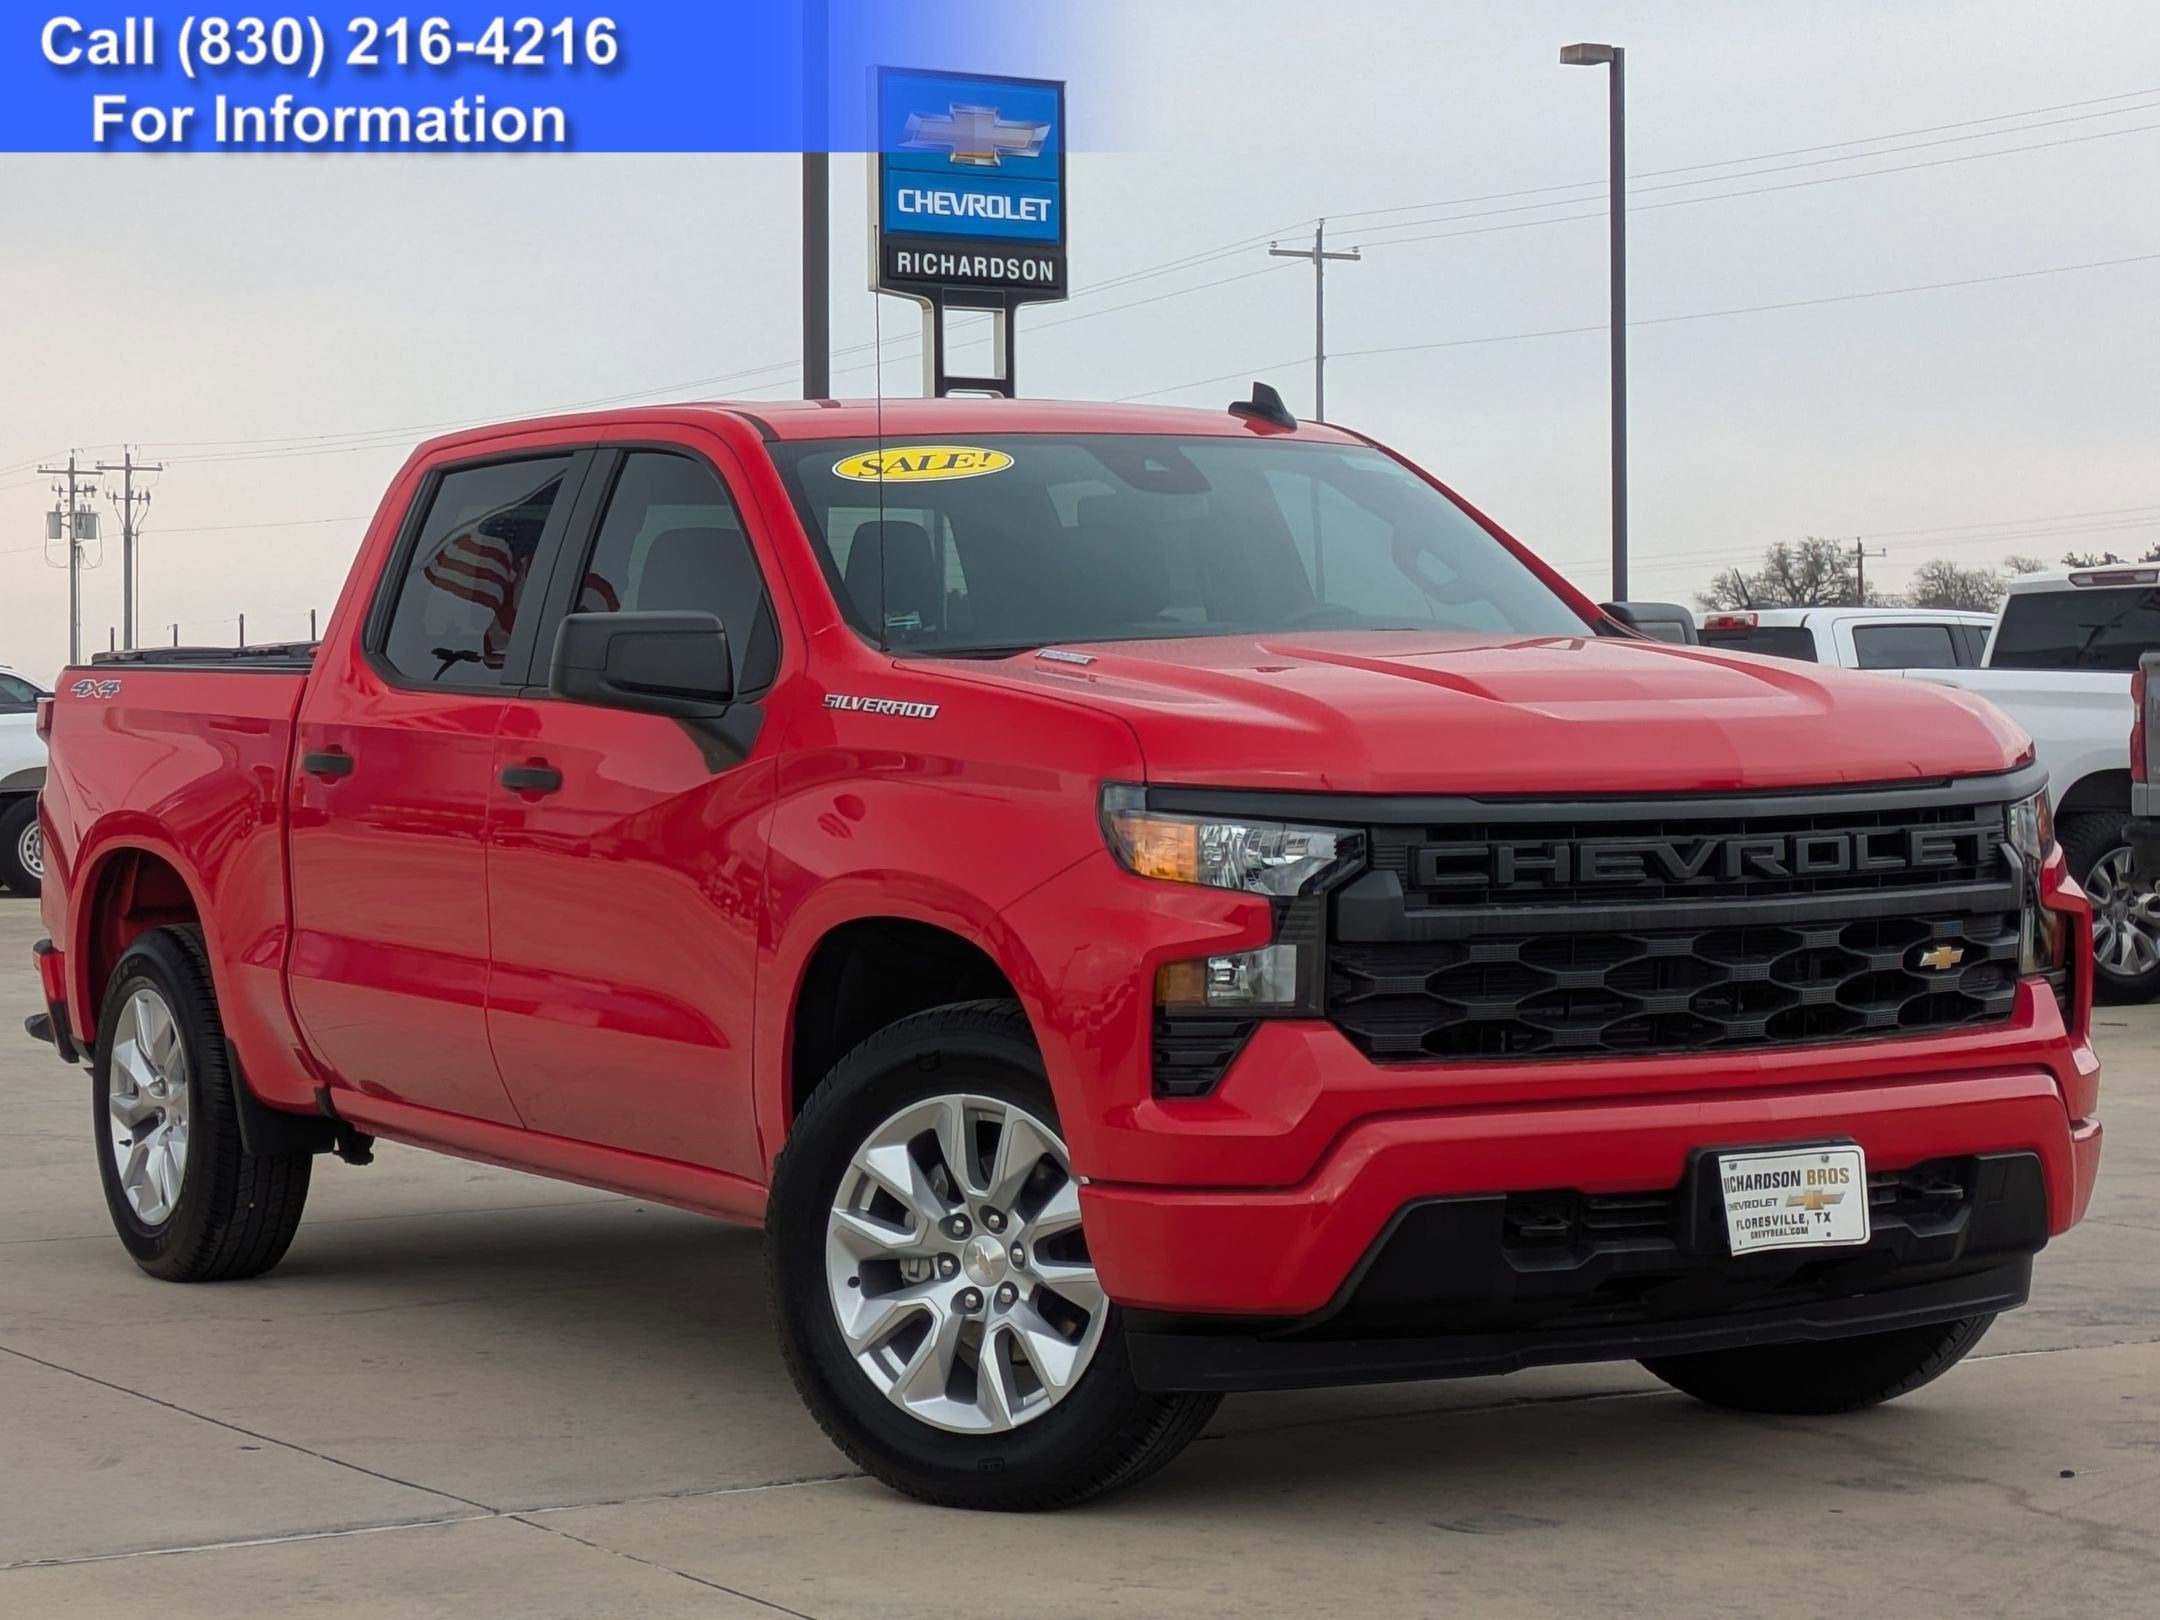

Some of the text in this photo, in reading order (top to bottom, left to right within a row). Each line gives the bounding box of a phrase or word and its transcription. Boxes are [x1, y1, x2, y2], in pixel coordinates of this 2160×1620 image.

[898, 189, 1052, 222] CHEVROLET
[897, 252, 1053, 282] RICHARDSON
[857, 452, 992, 478] SALE!
[822, 694, 940, 720] SILVERADO
[1416, 825, 2004, 888] CHEVROLET
[1806, 1168, 1850, 1186] BROS
[1736, 1212, 1832, 1232] FLORESVILLE, TX
